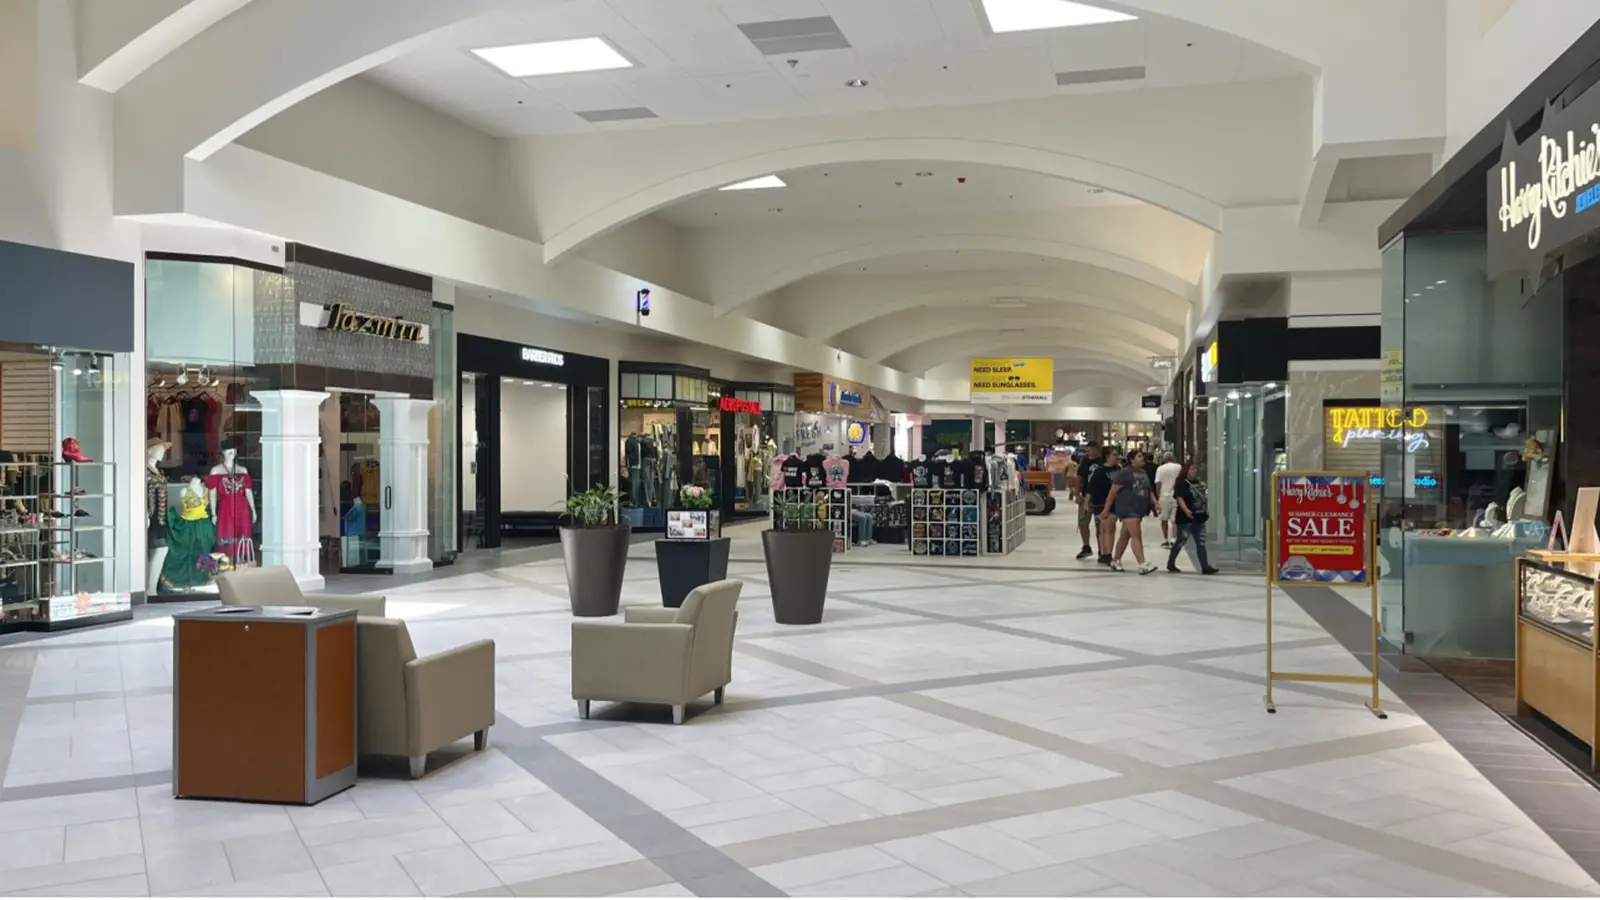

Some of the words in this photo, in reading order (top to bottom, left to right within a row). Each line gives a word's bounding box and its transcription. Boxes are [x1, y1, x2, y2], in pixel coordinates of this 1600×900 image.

[1499, 161, 1542, 250] Harry
[1330, 408, 1428, 428] TATTOO
[1281, 479, 1303, 504] Harry
[1287, 517, 1355, 537] SALE
